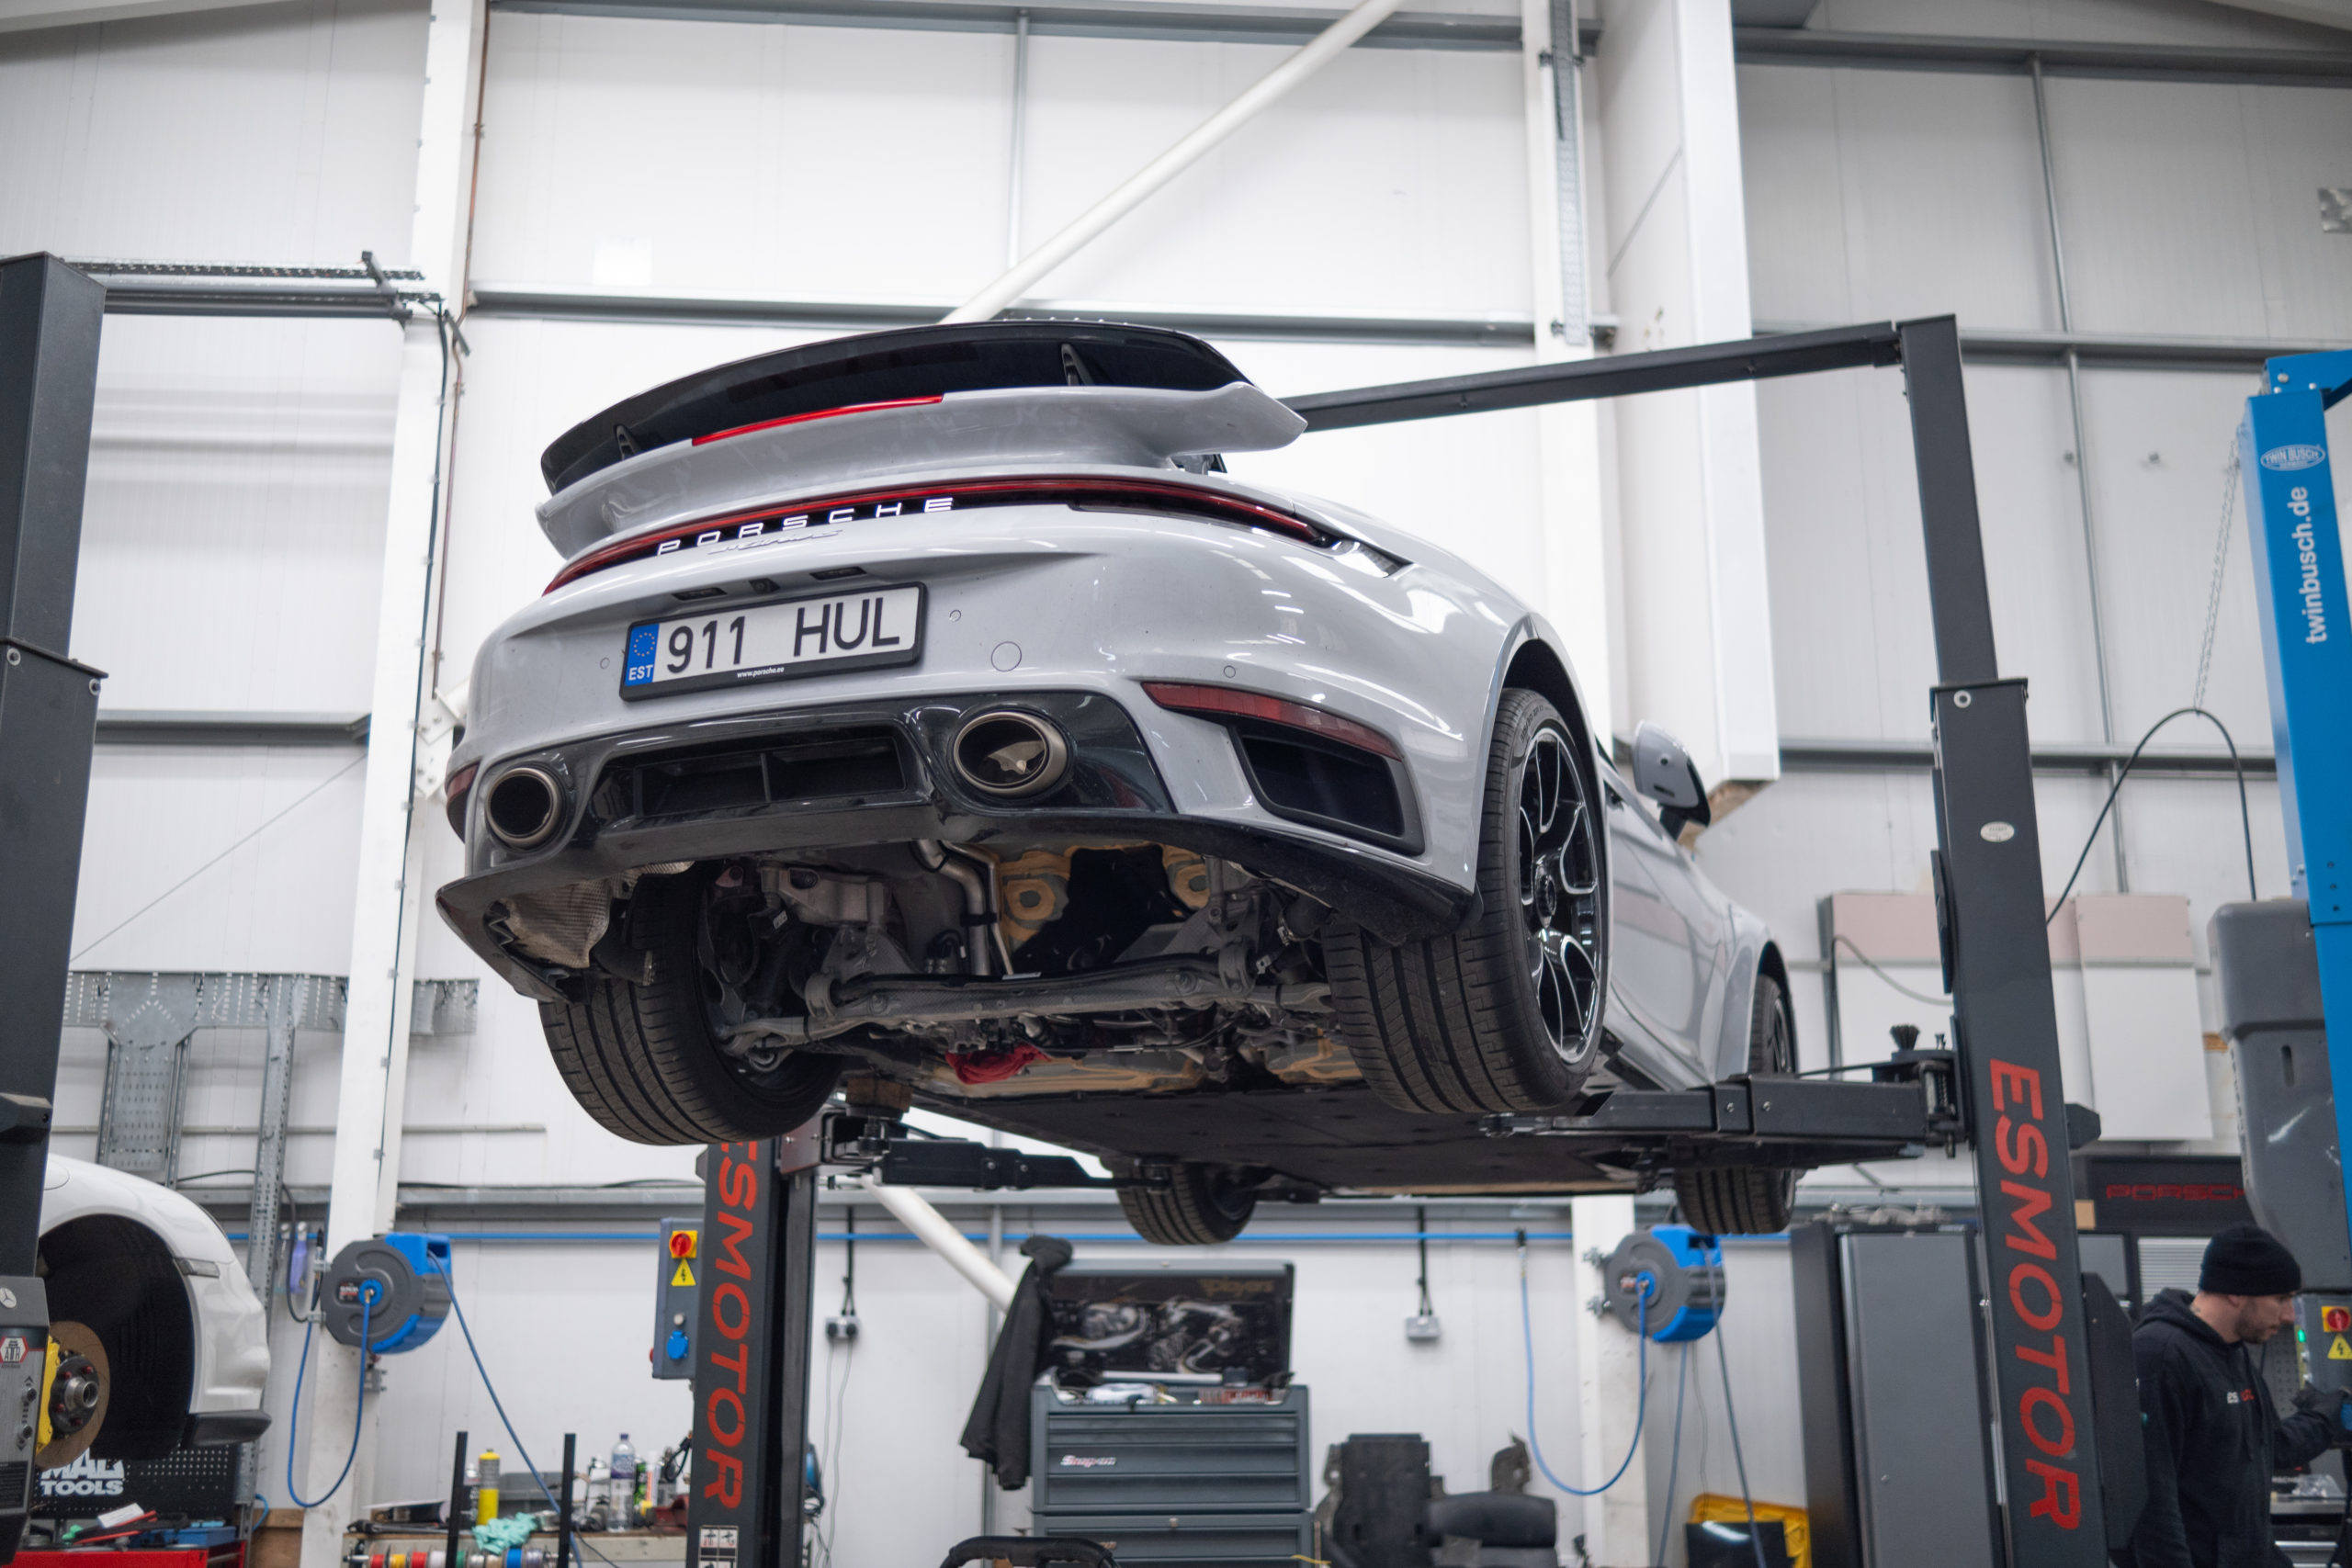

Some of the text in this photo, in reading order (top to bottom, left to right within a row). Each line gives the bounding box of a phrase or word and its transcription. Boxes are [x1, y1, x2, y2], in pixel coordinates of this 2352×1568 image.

[657, 497, 954, 556] PORSCHE
[2287, 486, 2327, 644] twinbusch.de
[666, 596, 900, 673] 911 HUL
[628, 664, 654, 681] EST
[2106, 1184, 2245, 1201] PORSC
[1989, 1058, 2081, 1530] ESMOTOR
[40, 1480, 124, 1495] TOOLS
